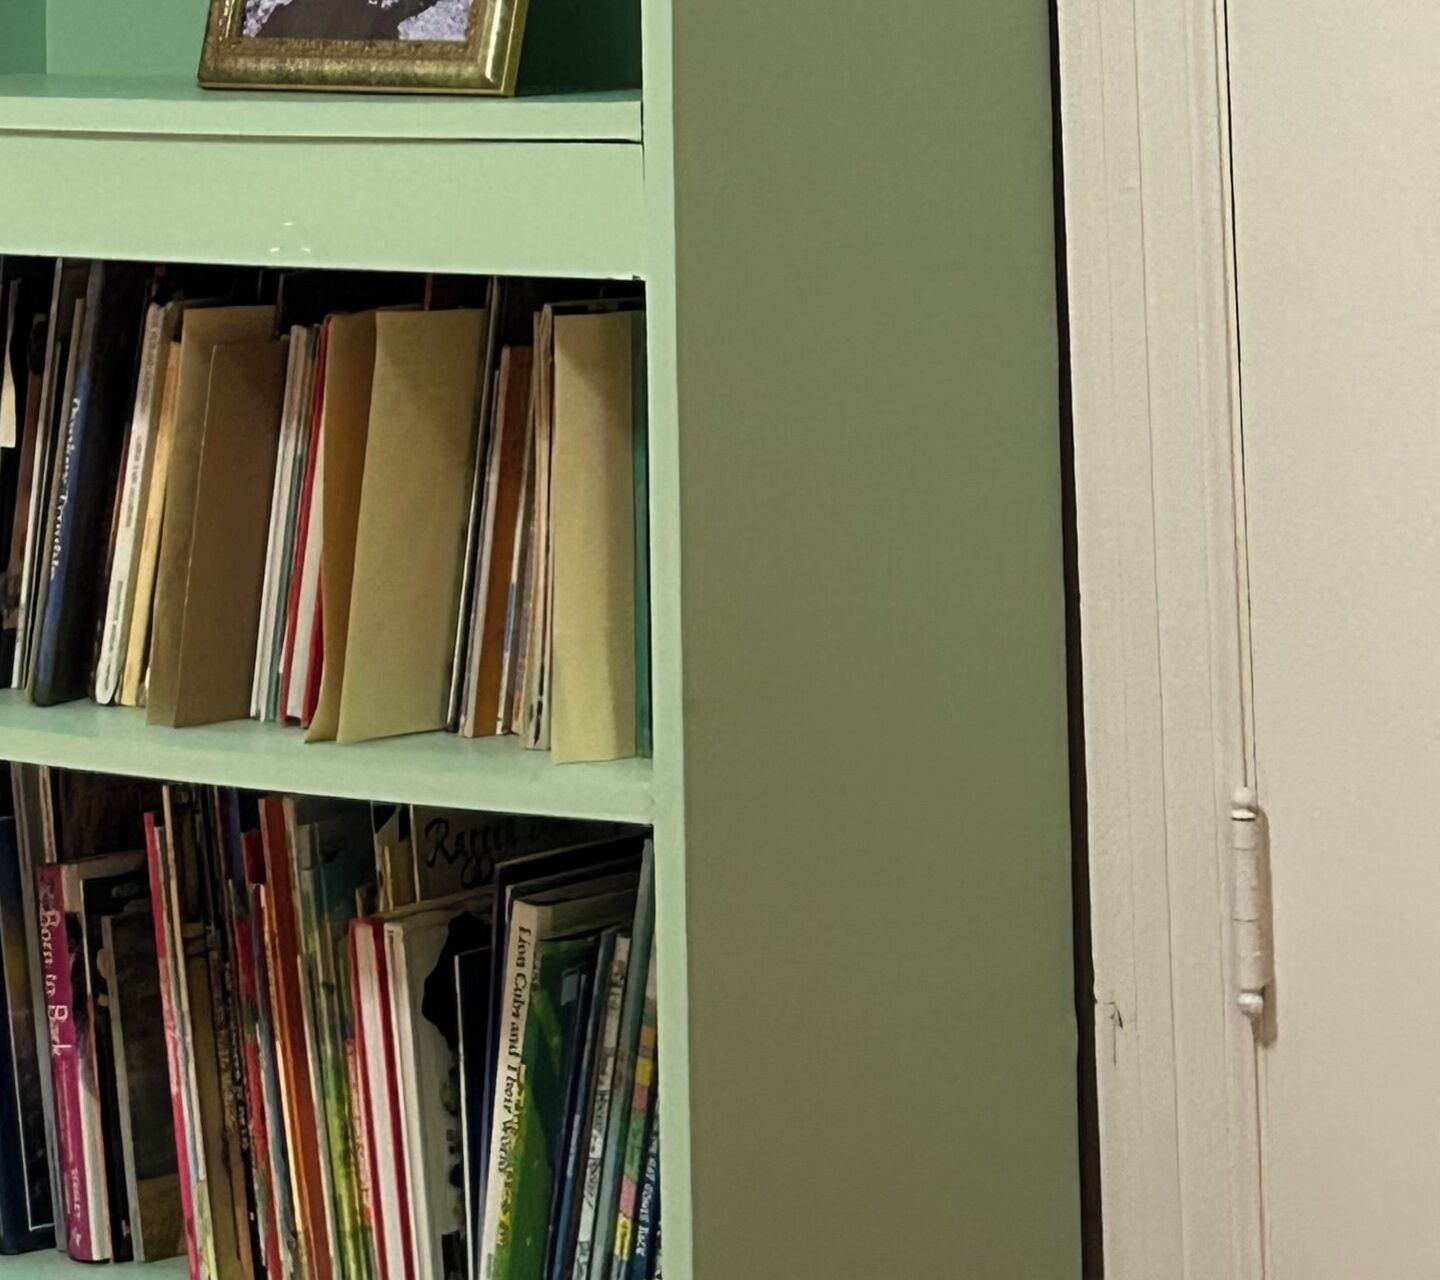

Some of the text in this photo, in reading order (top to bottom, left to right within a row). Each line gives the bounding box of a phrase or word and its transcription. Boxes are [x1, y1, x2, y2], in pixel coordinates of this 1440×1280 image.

[39, 909, 63, 964] Born
[514, 925, 533, 969] Lion
[509, 972, 528, 1020] Cubs
[506, 1020, 523, 1057] and
